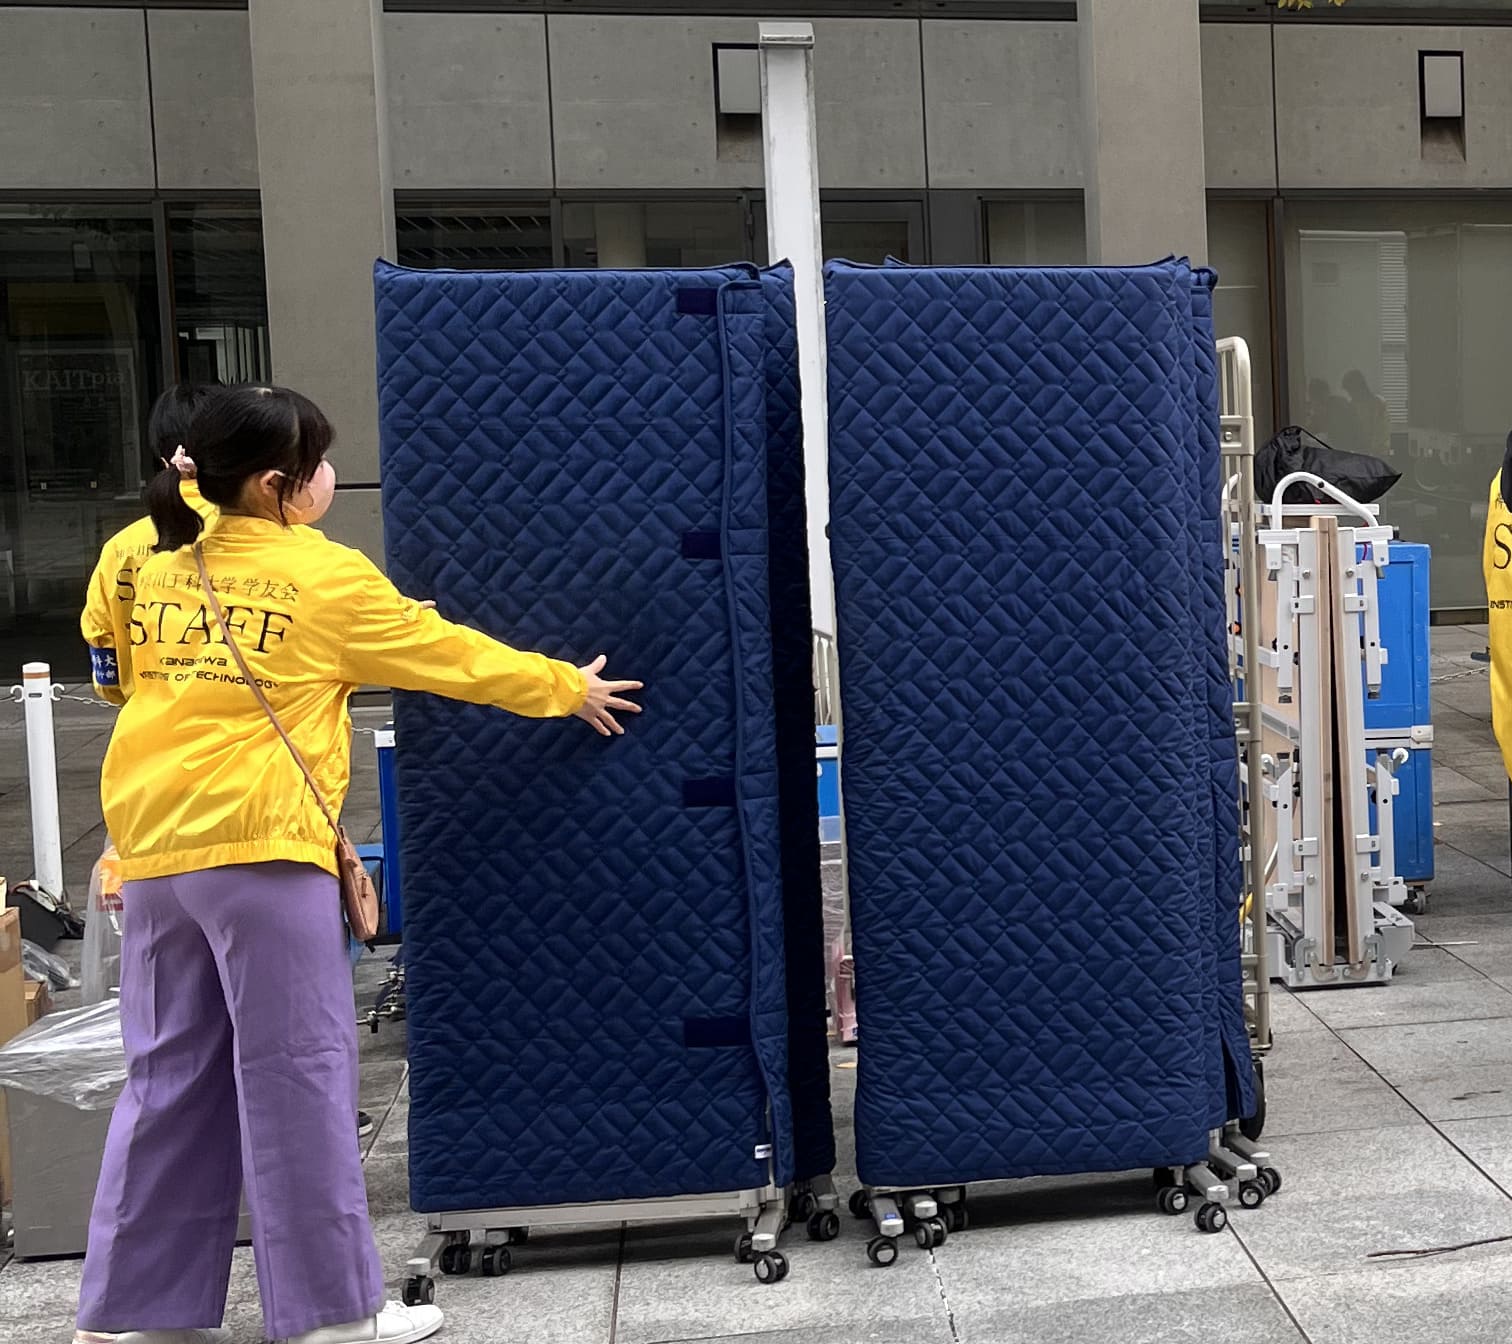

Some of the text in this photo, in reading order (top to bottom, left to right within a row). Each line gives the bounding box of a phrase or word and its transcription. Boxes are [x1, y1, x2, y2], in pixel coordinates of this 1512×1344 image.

[116, 567, 140, 602] S
[243, 577, 299, 602] 学友会
[129, 600, 294, 654] STAFF
